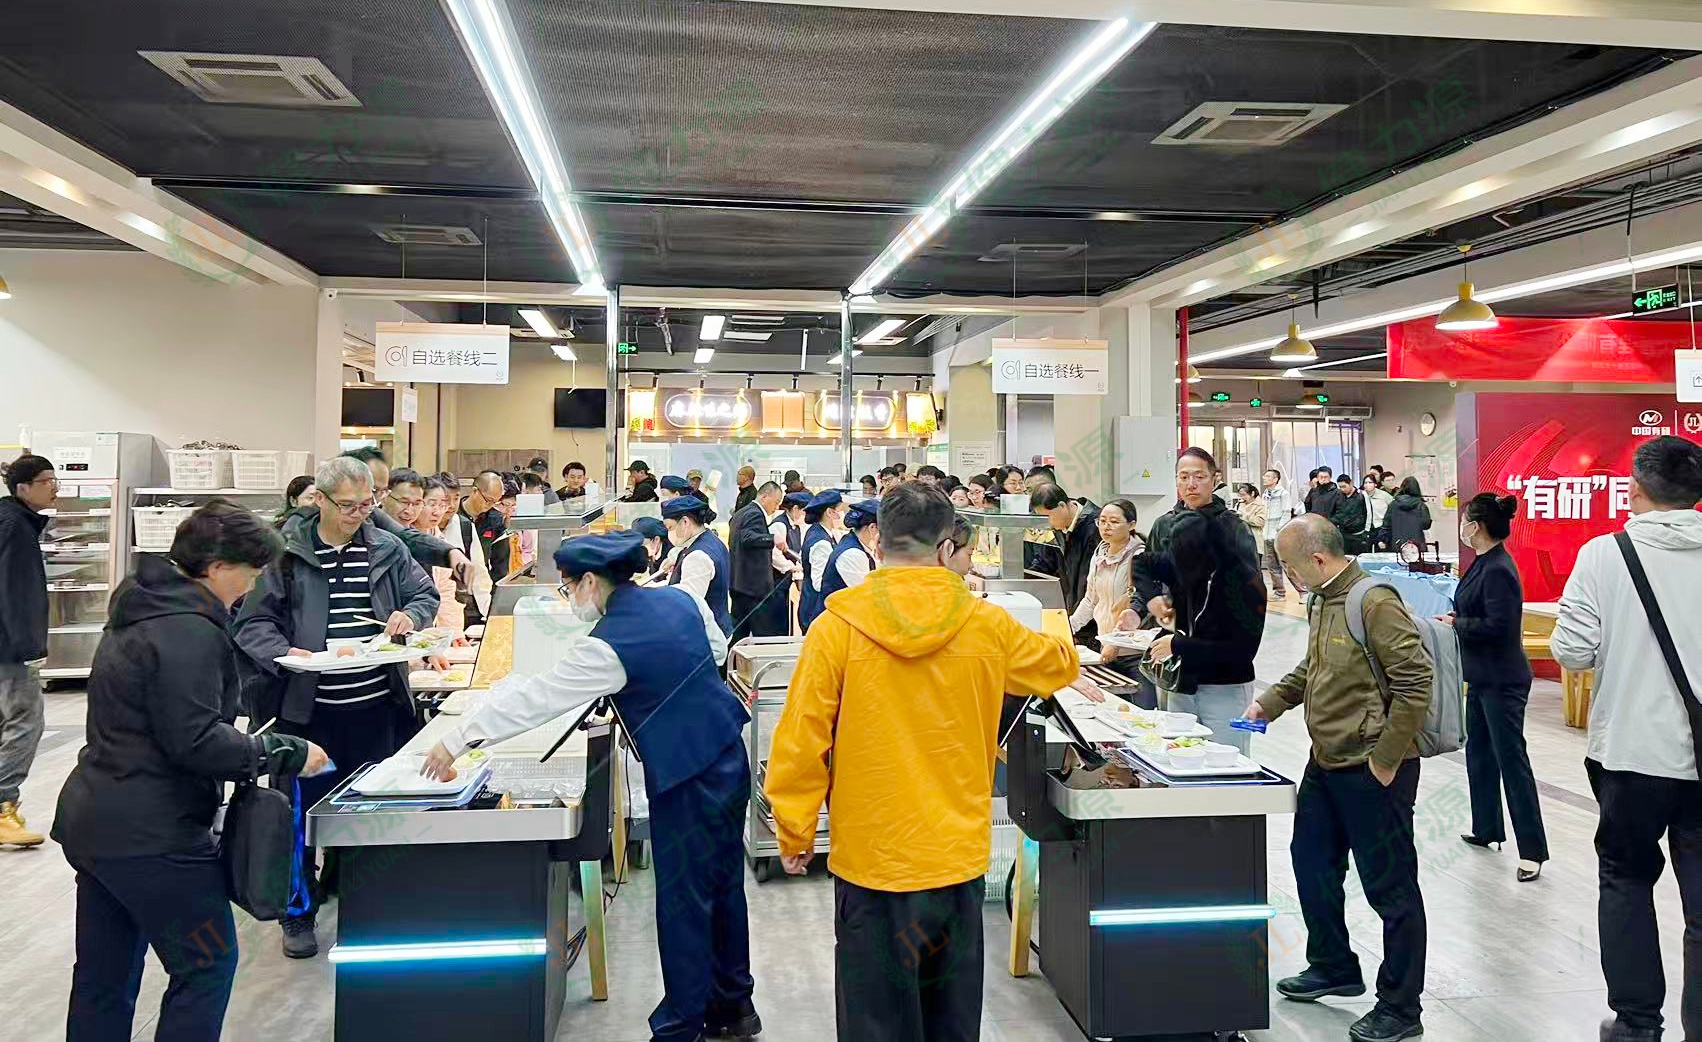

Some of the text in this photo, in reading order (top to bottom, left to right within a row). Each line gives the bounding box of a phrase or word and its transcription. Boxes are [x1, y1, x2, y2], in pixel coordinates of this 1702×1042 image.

[412, 350, 498, 366] 自选餐线二
[1025, 363, 1099, 379] 自选餐线一
